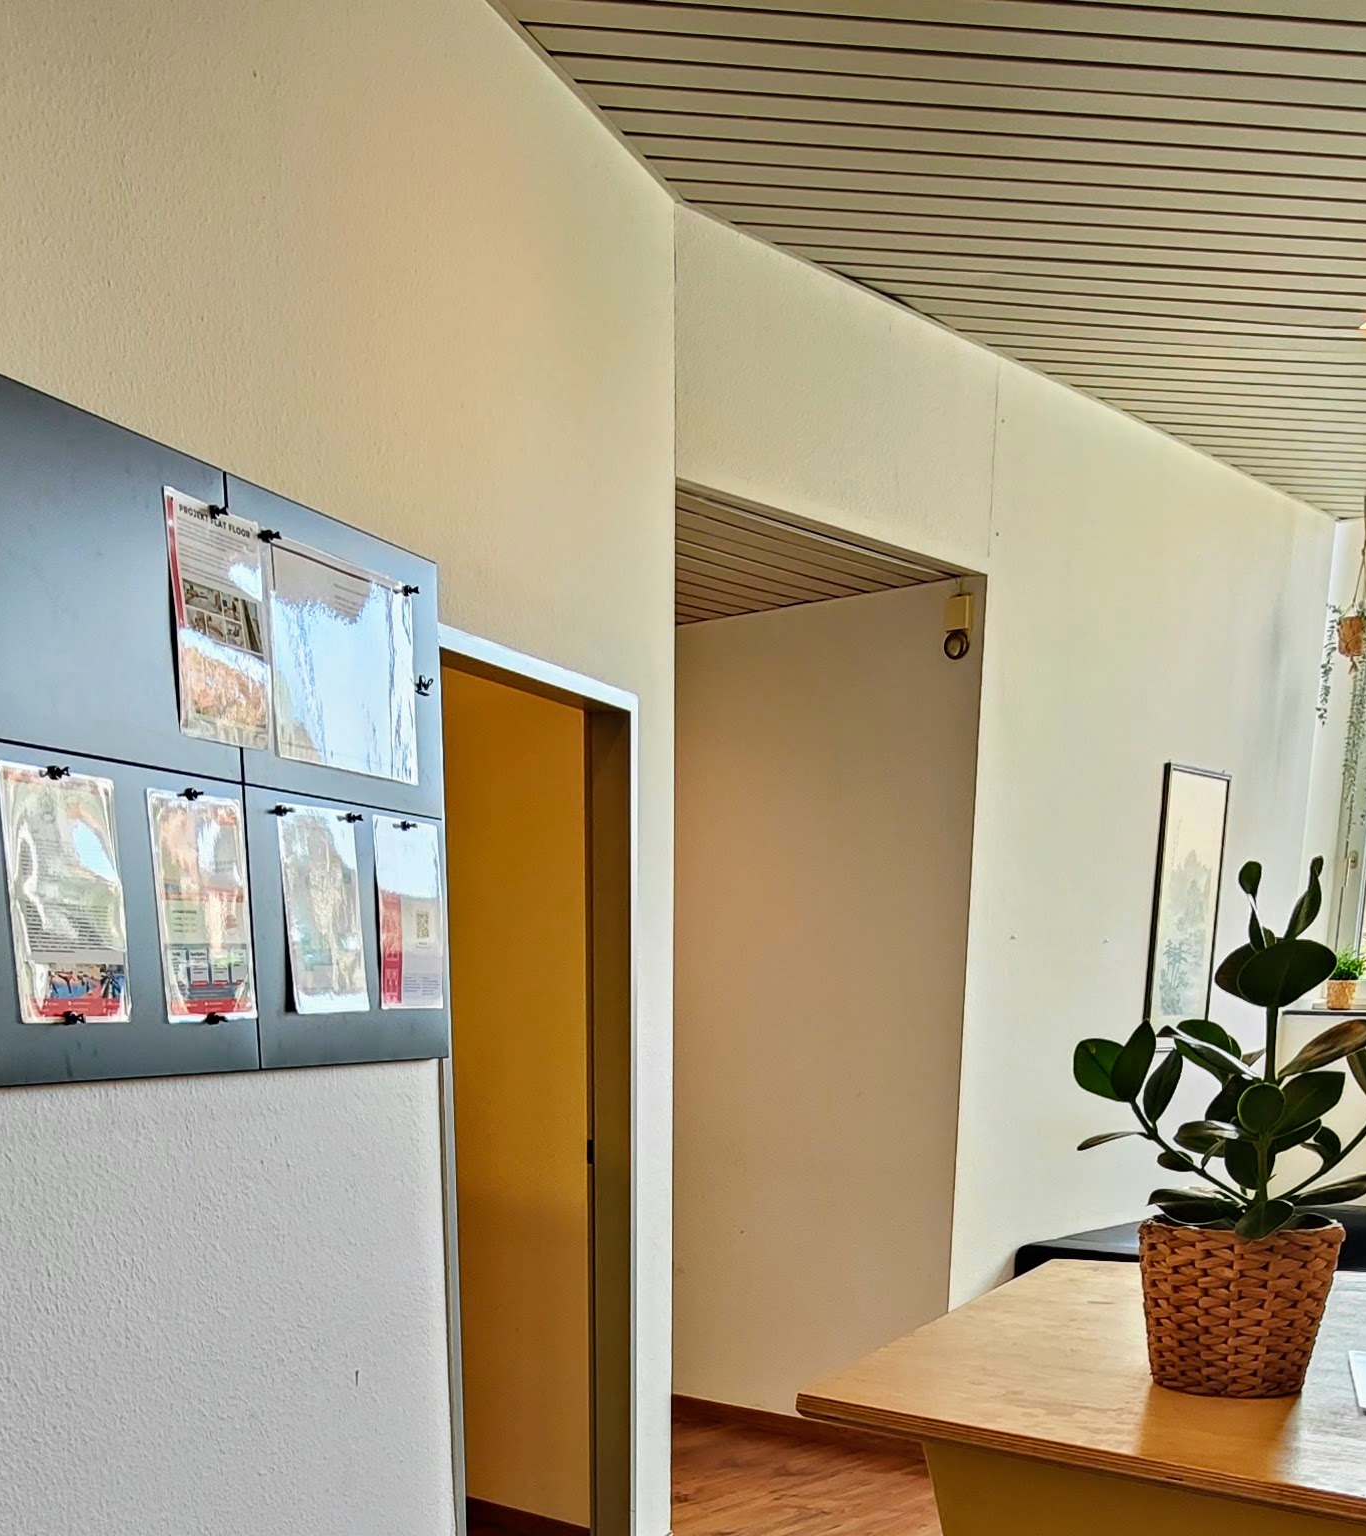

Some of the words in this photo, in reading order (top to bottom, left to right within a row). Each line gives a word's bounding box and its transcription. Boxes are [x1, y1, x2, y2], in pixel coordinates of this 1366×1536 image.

[178, 503, 209, 522] PROJEKT
[210, 517, 227, 530] FLAT
[228, 523, 251, 538] FLOOR
